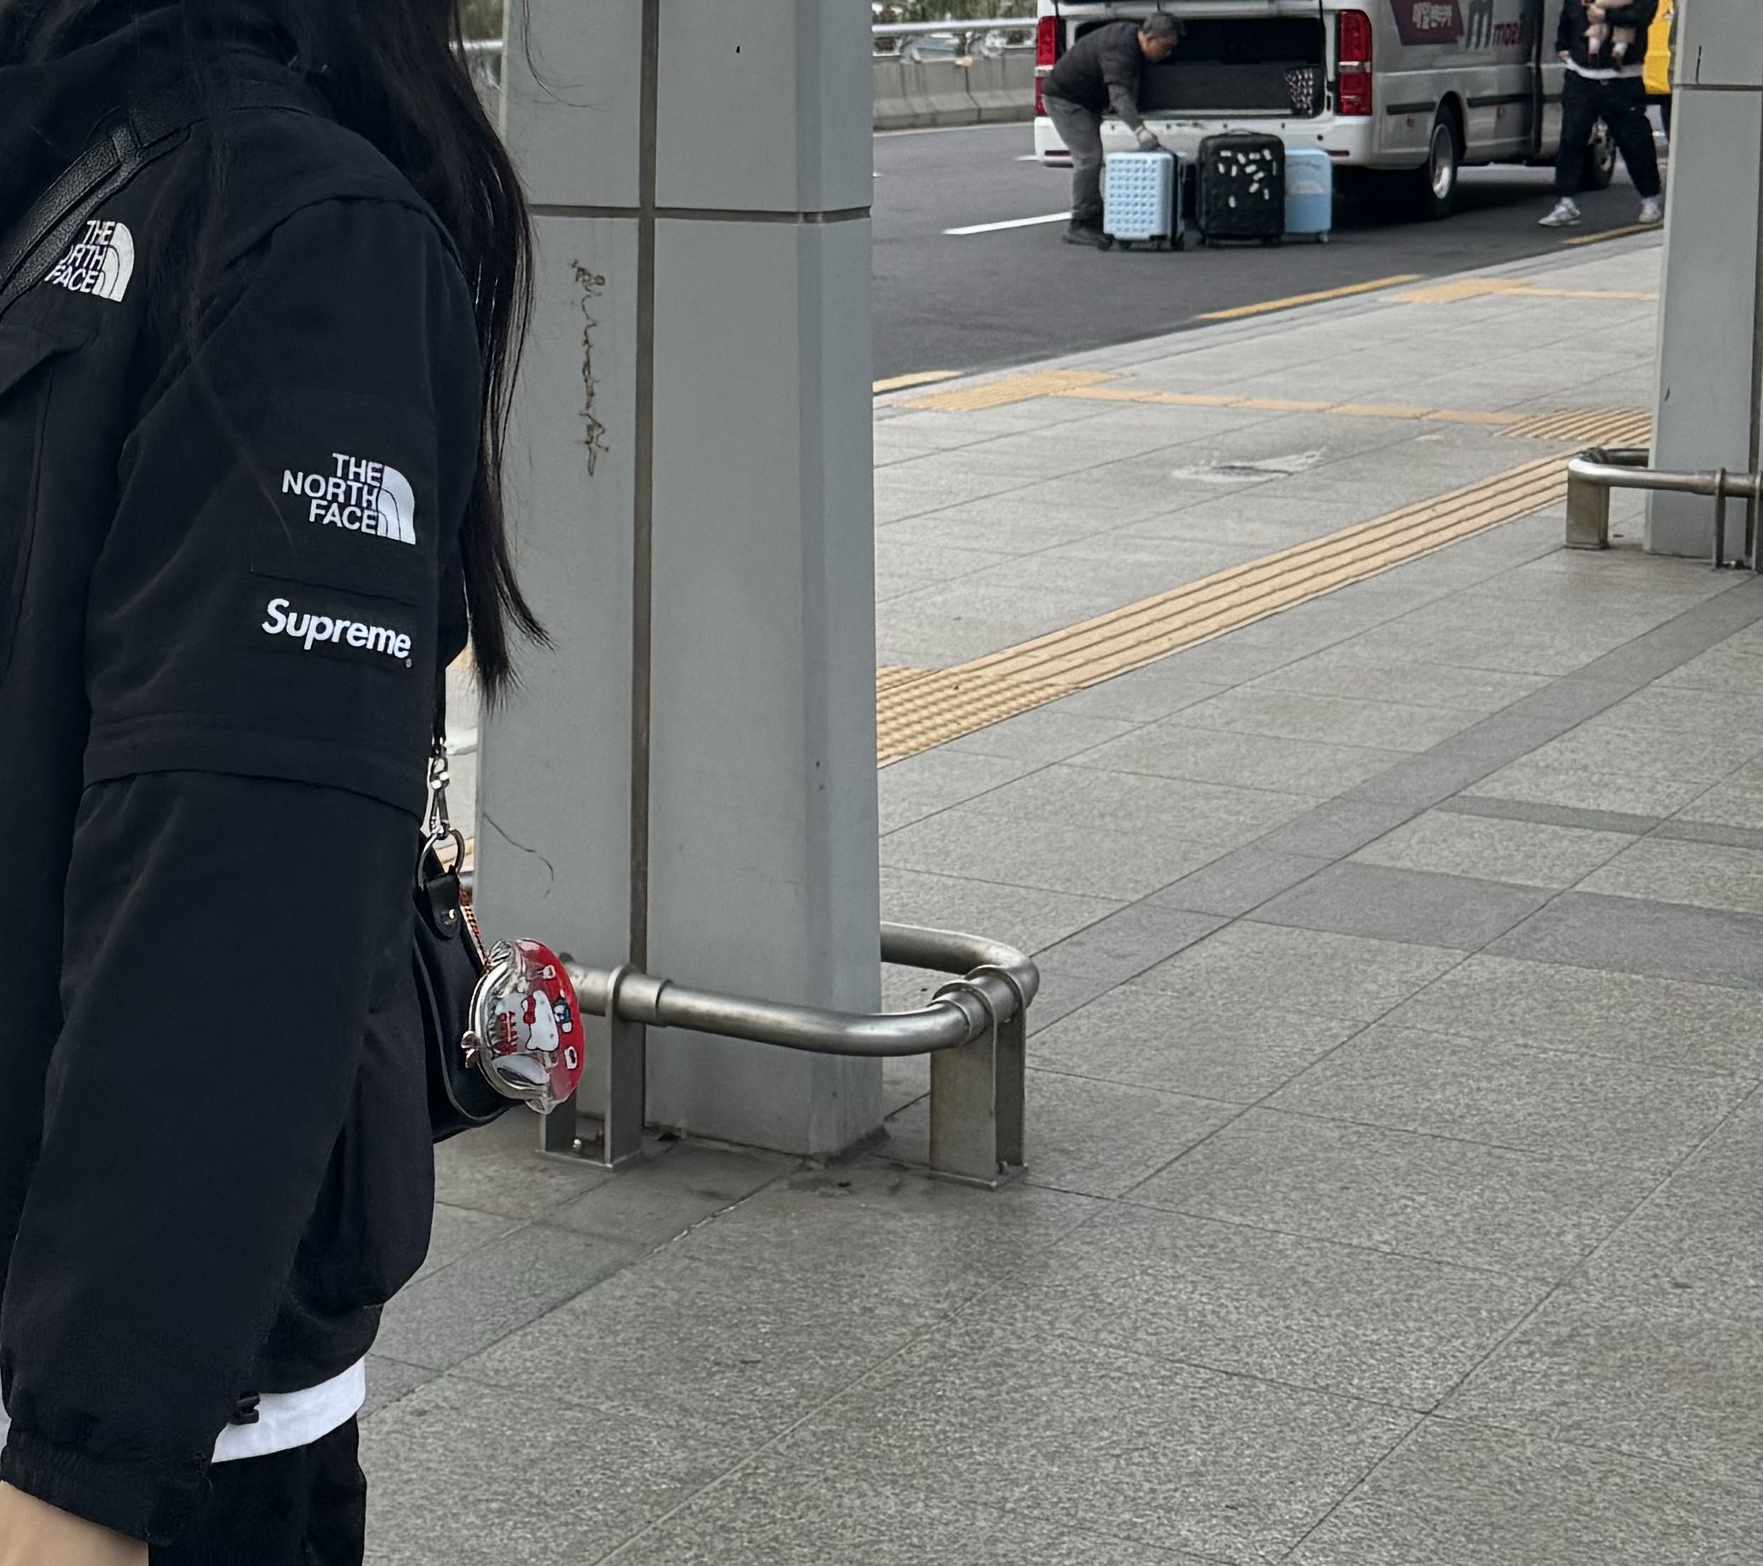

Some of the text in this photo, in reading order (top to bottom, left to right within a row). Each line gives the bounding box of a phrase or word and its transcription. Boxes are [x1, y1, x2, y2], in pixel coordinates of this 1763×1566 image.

[83, 220, 116, 245] THE
[59, 244, 107, 270] RTH
[44, 265, 99, 293] FACE
[332, 453, 383, 487] THE
[282, 470, 380, 510] NORTH
[309, 499, 378, 535] FACE
[261, 598, 412, 659] Supreme
